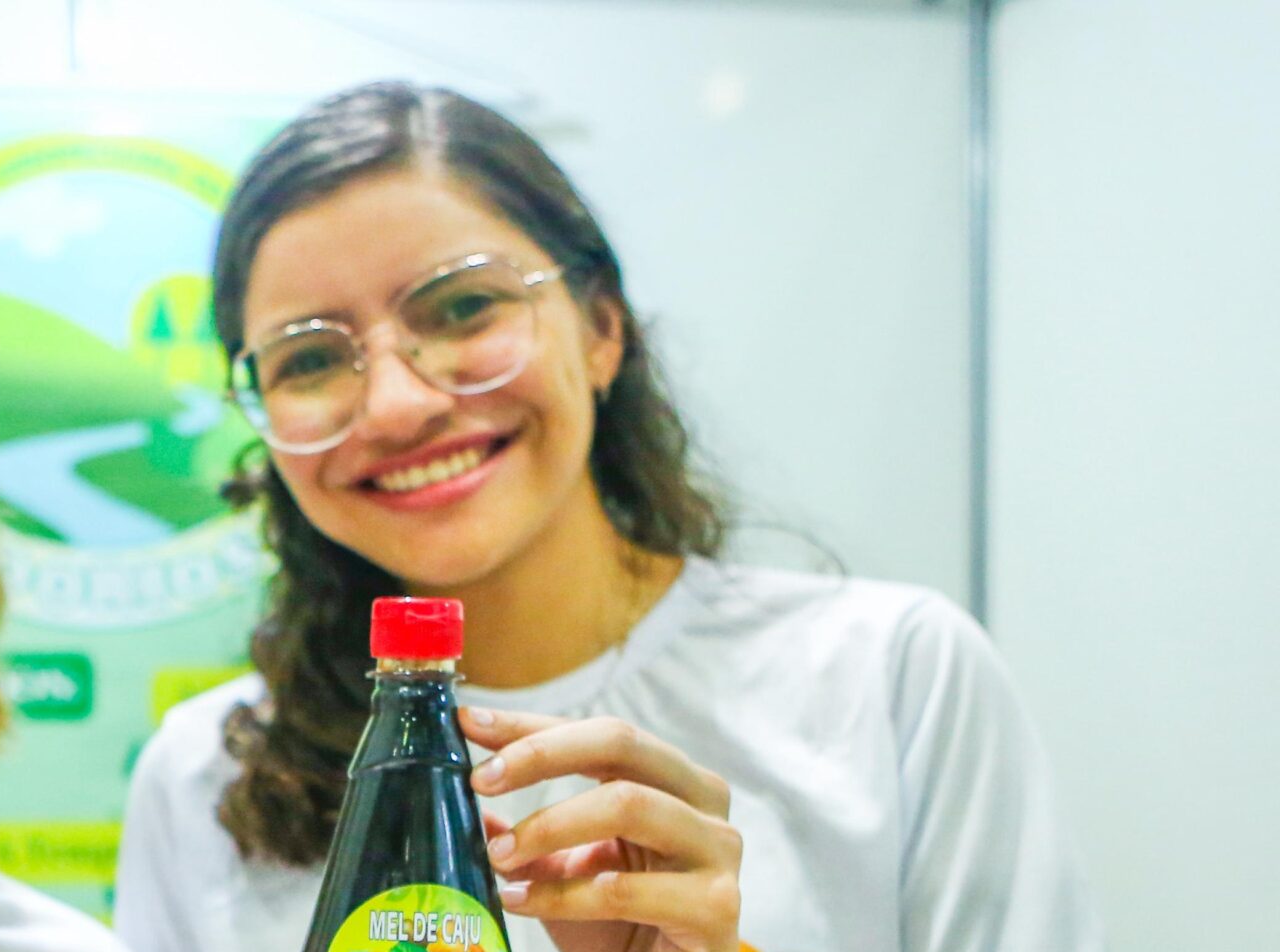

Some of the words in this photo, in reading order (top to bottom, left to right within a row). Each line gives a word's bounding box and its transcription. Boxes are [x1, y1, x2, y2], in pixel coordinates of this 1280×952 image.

[369, 911, 409, 941] MEL
[413, 912, 438, 942] DE
[442, 913, 481, 952] CAJU
